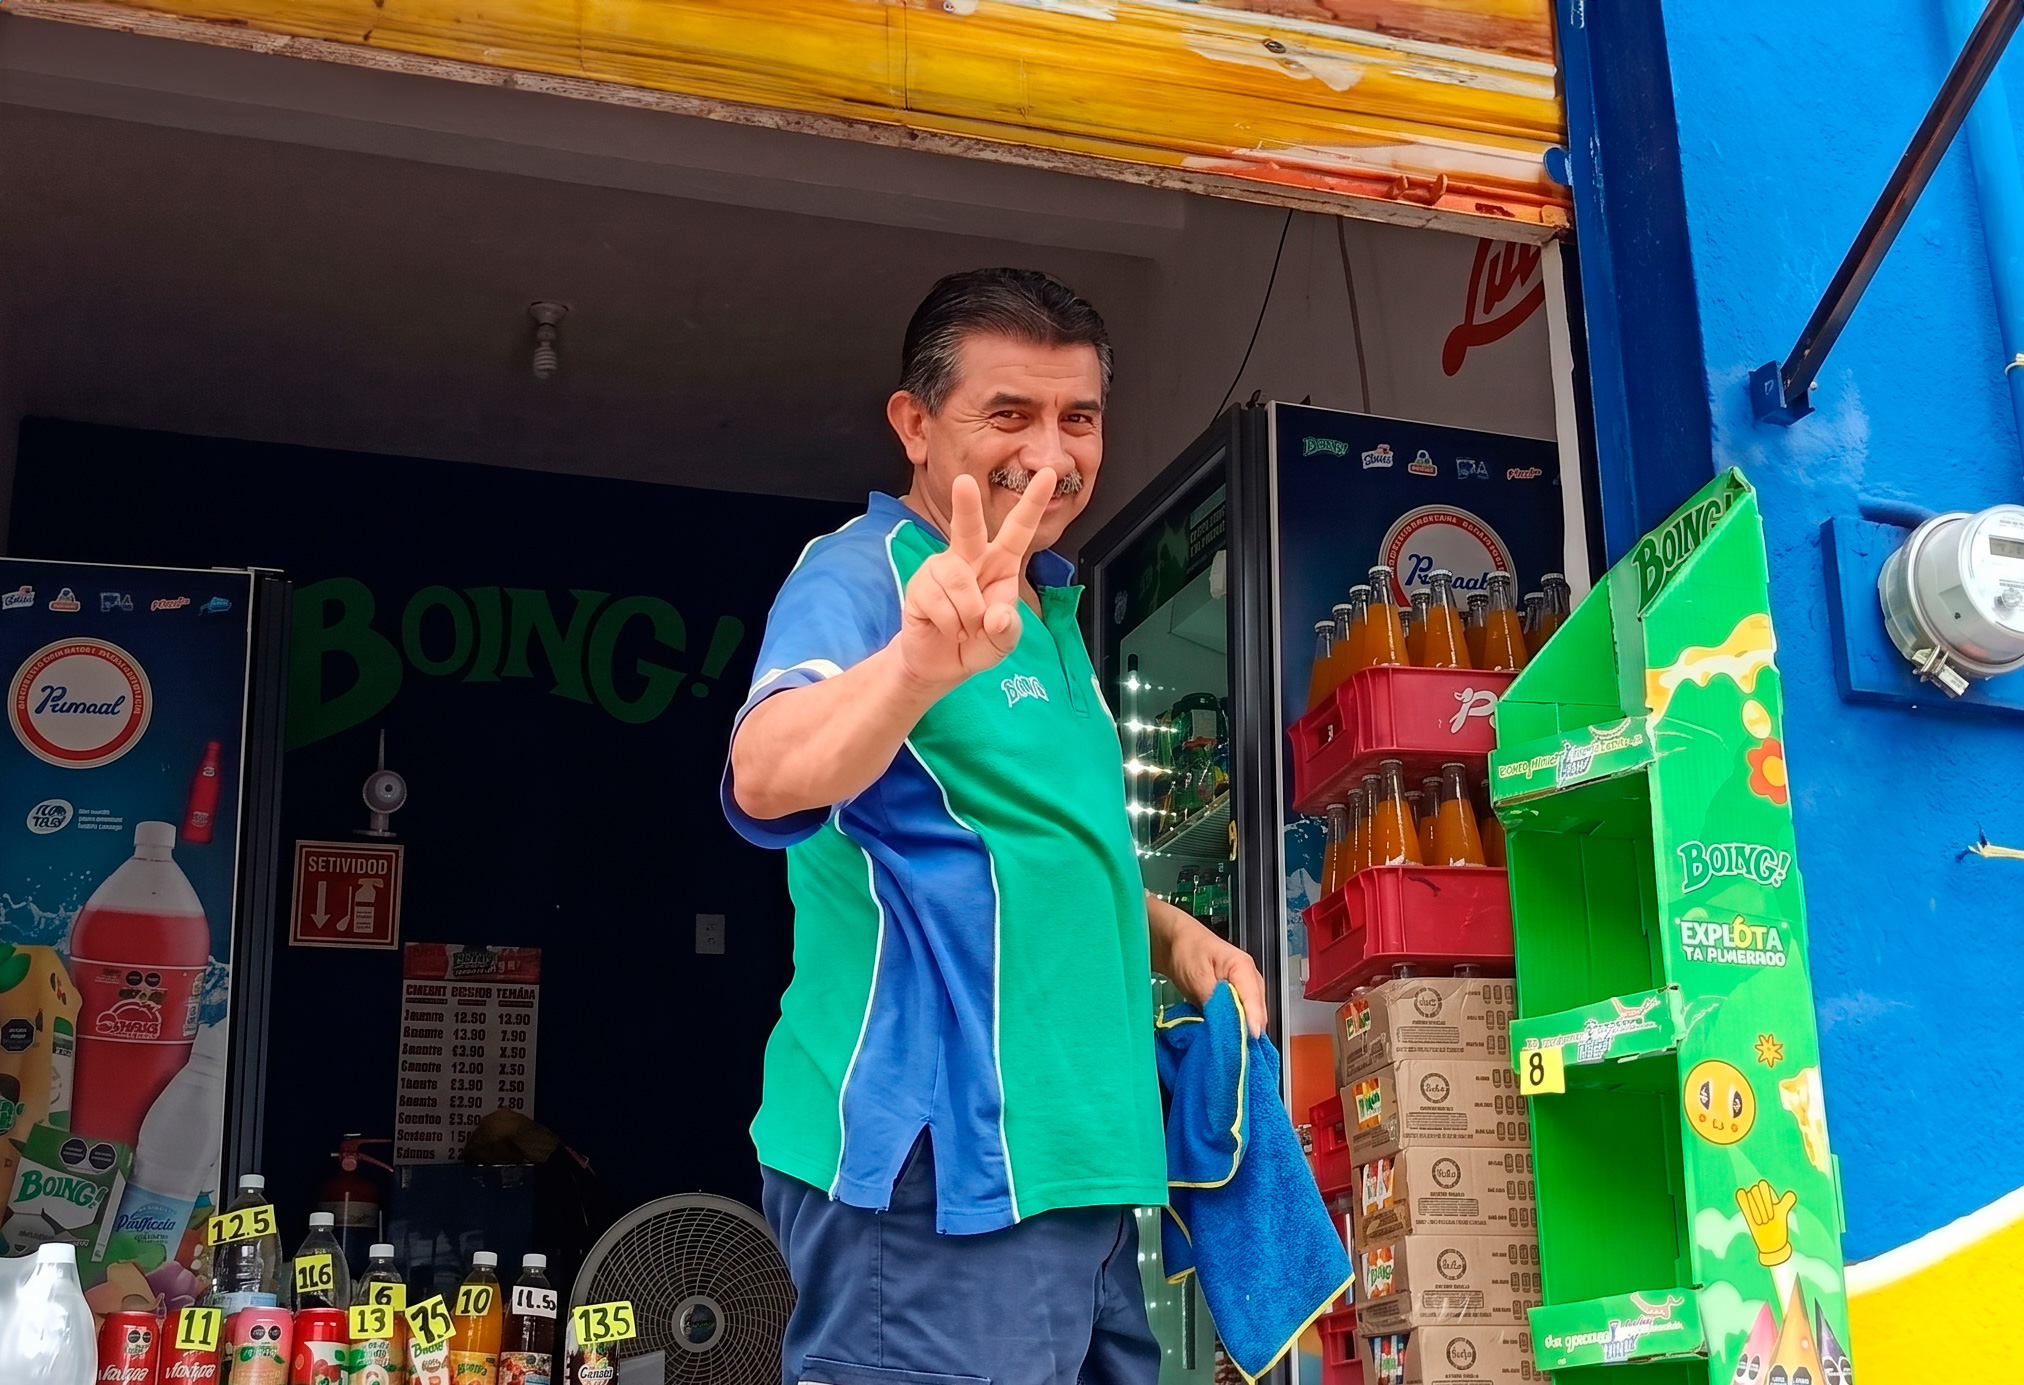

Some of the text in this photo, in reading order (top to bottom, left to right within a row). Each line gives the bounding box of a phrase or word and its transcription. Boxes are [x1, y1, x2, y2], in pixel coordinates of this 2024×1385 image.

[286, 577, 745, 753] BOING!
[1677, 840, 1791, 894] BOING!
[1529, 1052, 1544, 1086] 8
[19, 1170, 108, 1209] BOING!
[212, 1209, 270, 1244] 12.5
[375, 1286, 393, 1306] 6
[461, 1288, 490, 1314] 10
[181, 1309, 213, 1346] 11
[357, 1308, 386, 1333] 13
[579, 1305, 630, 1342] 13.5
